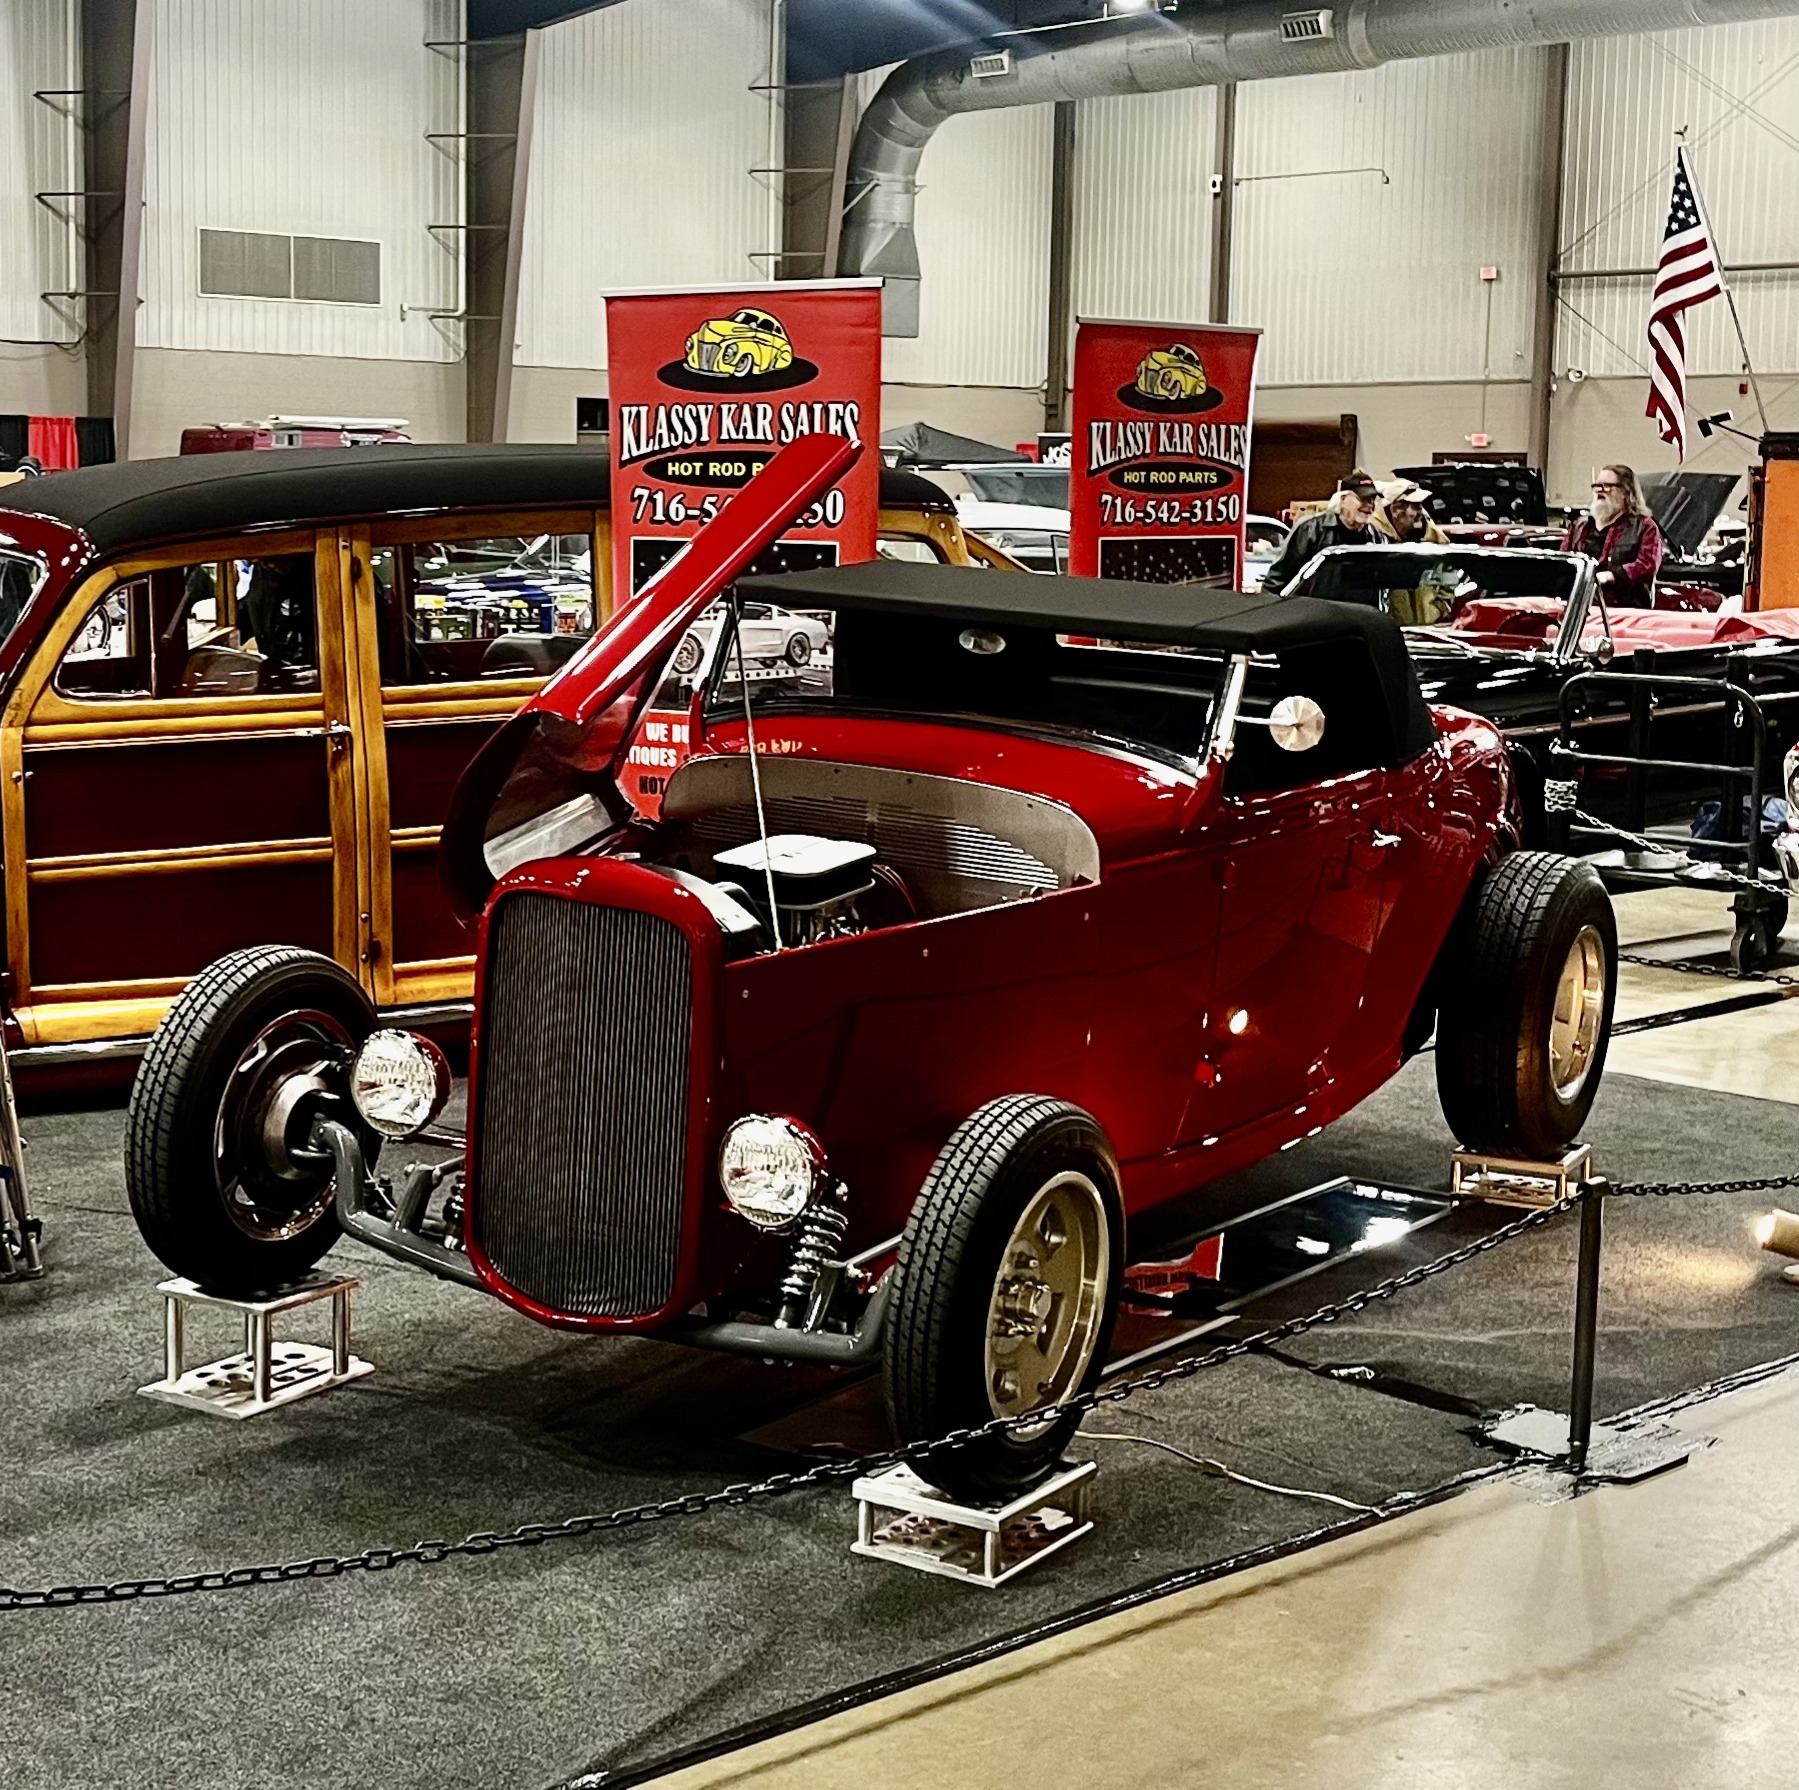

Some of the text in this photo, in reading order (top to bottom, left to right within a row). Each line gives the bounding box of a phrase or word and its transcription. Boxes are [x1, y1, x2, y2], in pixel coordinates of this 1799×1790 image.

[618, 401, 859, 462] KLASSY KAR SALES
[1089, 421, 1246, 471] KLASSY KAR SALES
[667, 462, 702, 477] HOT
[709, 462, 746, 477] ROD
[1123, 472, 1218, 484] HOT ROD PARTS
[1101, 494, 1240, 523] 716-542-3150
[645, 722, 690, 744] WE BU
[626, 745, 677, 767] TIQUES
